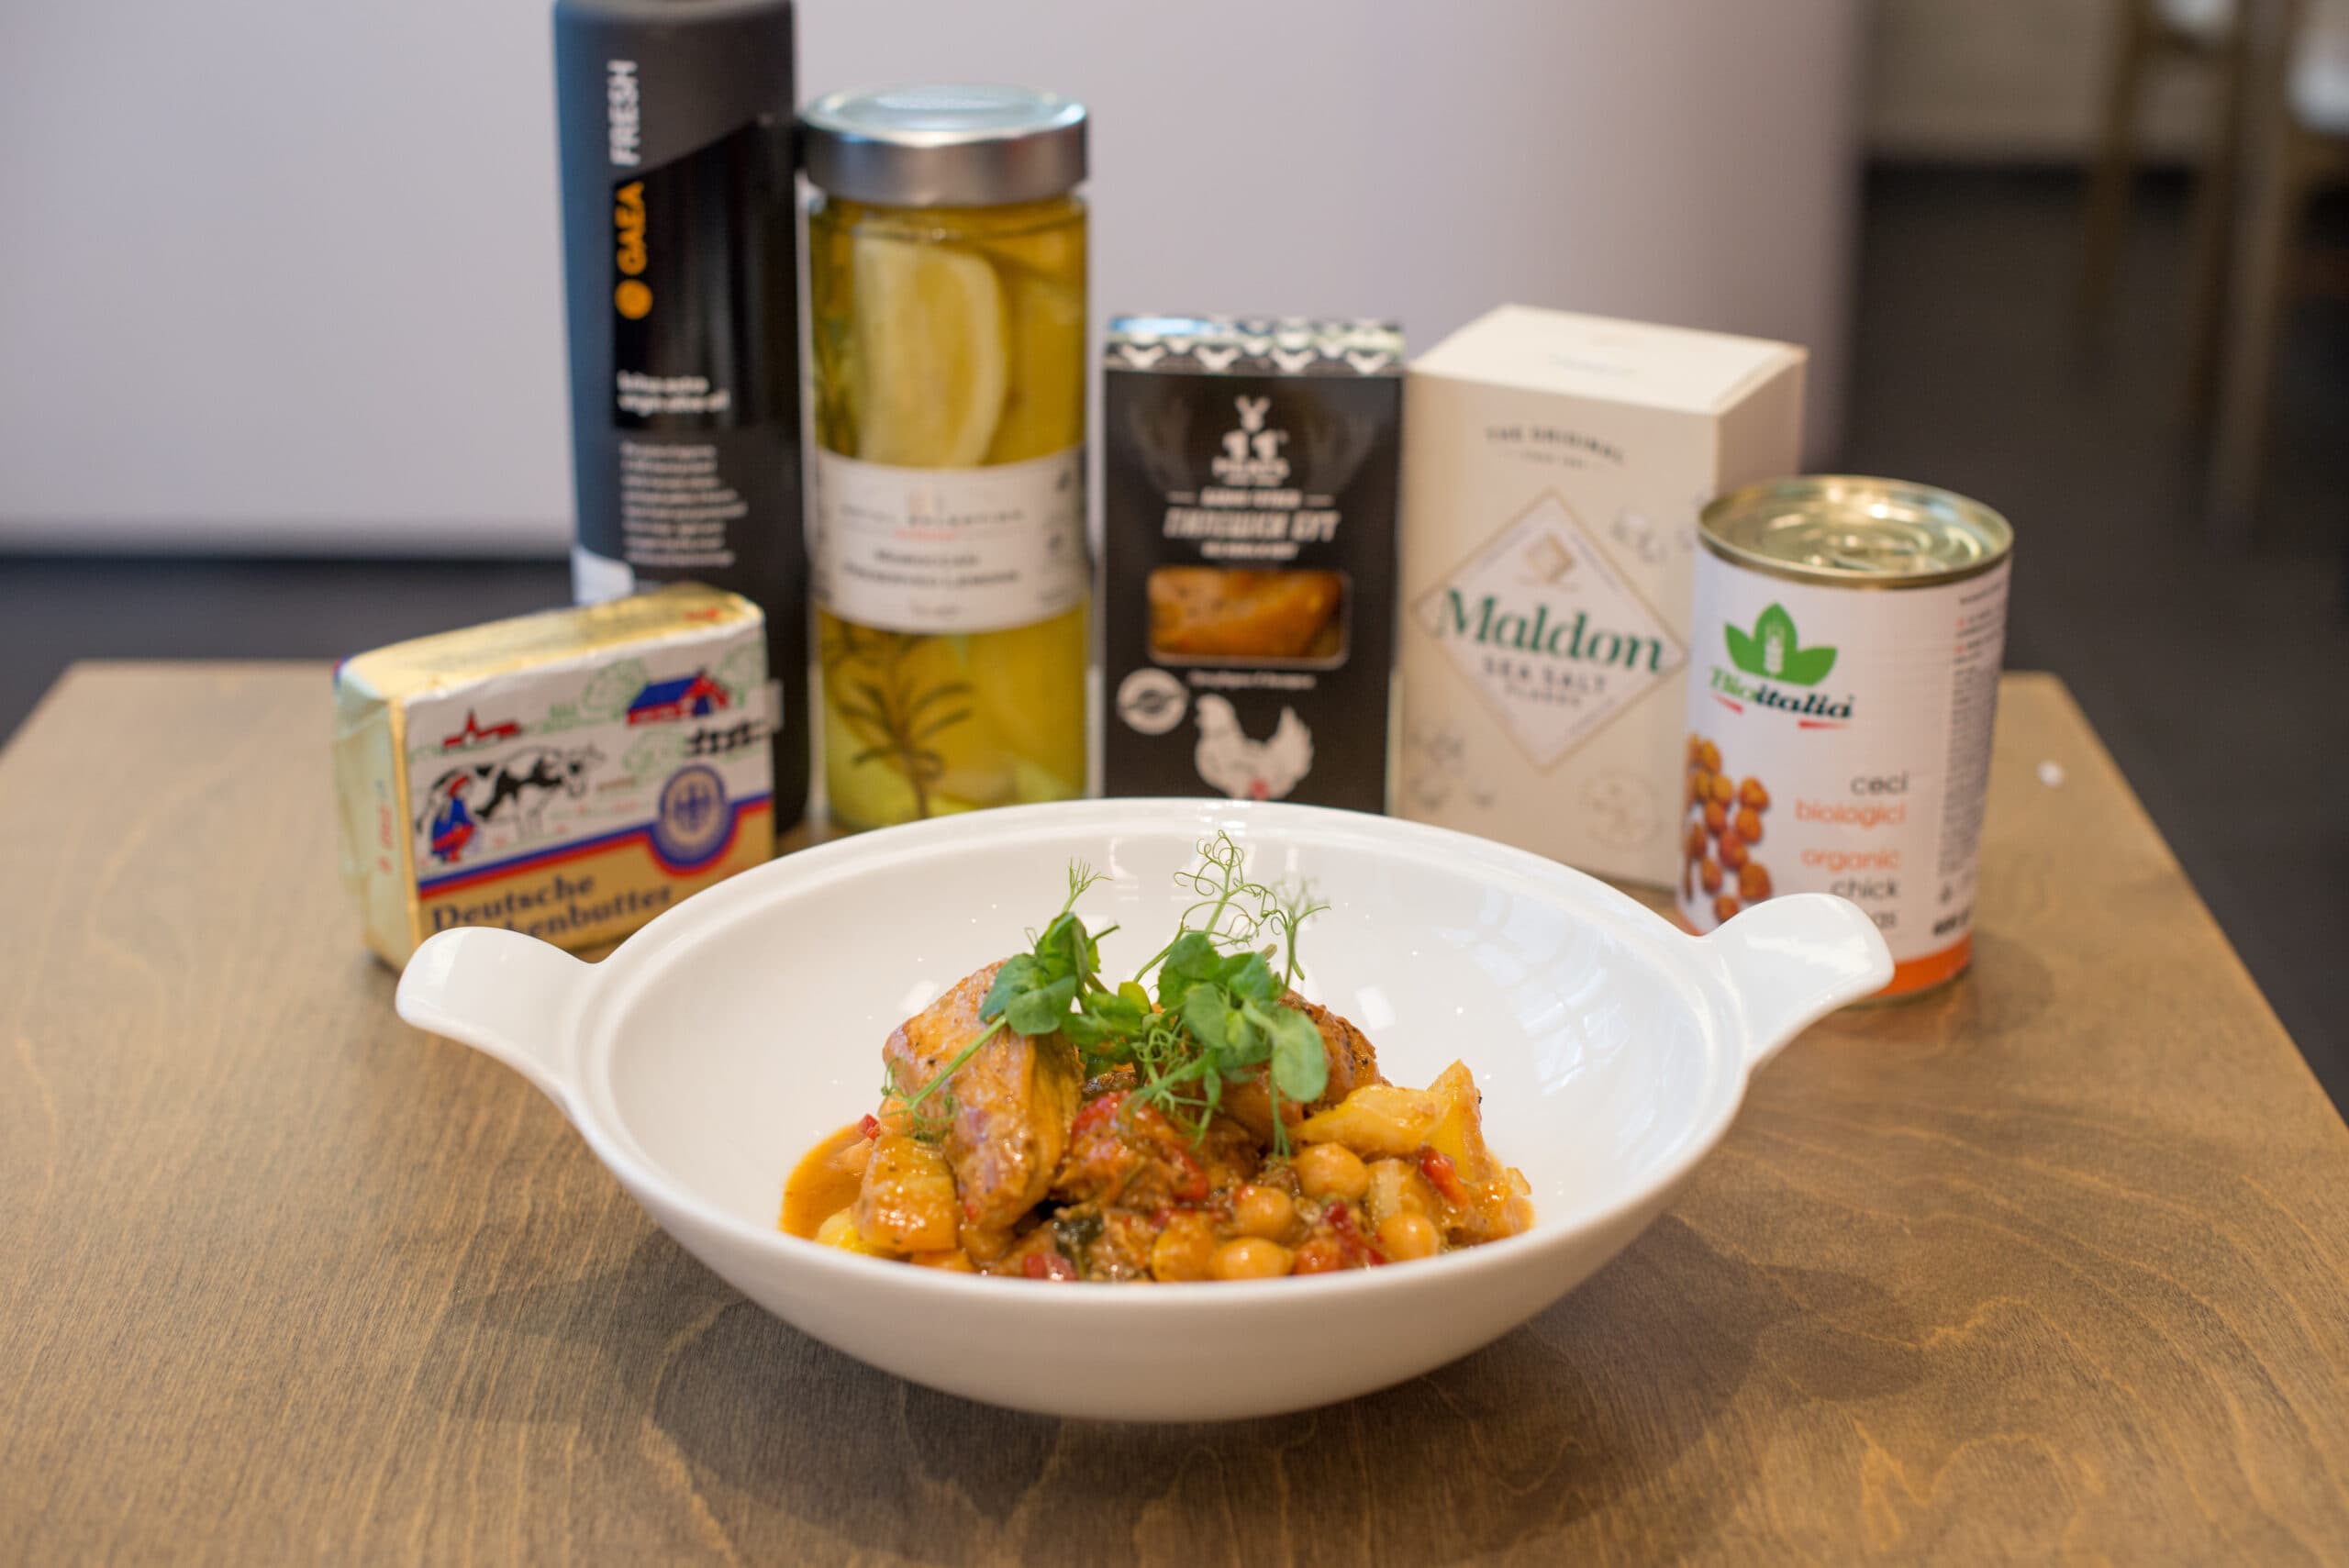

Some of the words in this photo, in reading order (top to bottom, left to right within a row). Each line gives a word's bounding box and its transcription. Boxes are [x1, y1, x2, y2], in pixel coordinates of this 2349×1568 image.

[607, 59, 641, 167] FRESH
[615, 181, 647, 275] GAEA
[1437, 588, 1663, 673] Maldon
[1850, 771, 1909, 795] ceci
[1794, 798, 1908, 829] biologici
[1799, 844, 1902, 873] organic
[432, 874, 595, 932] Deutsche
[1831, 876, 1898, 900] chick
